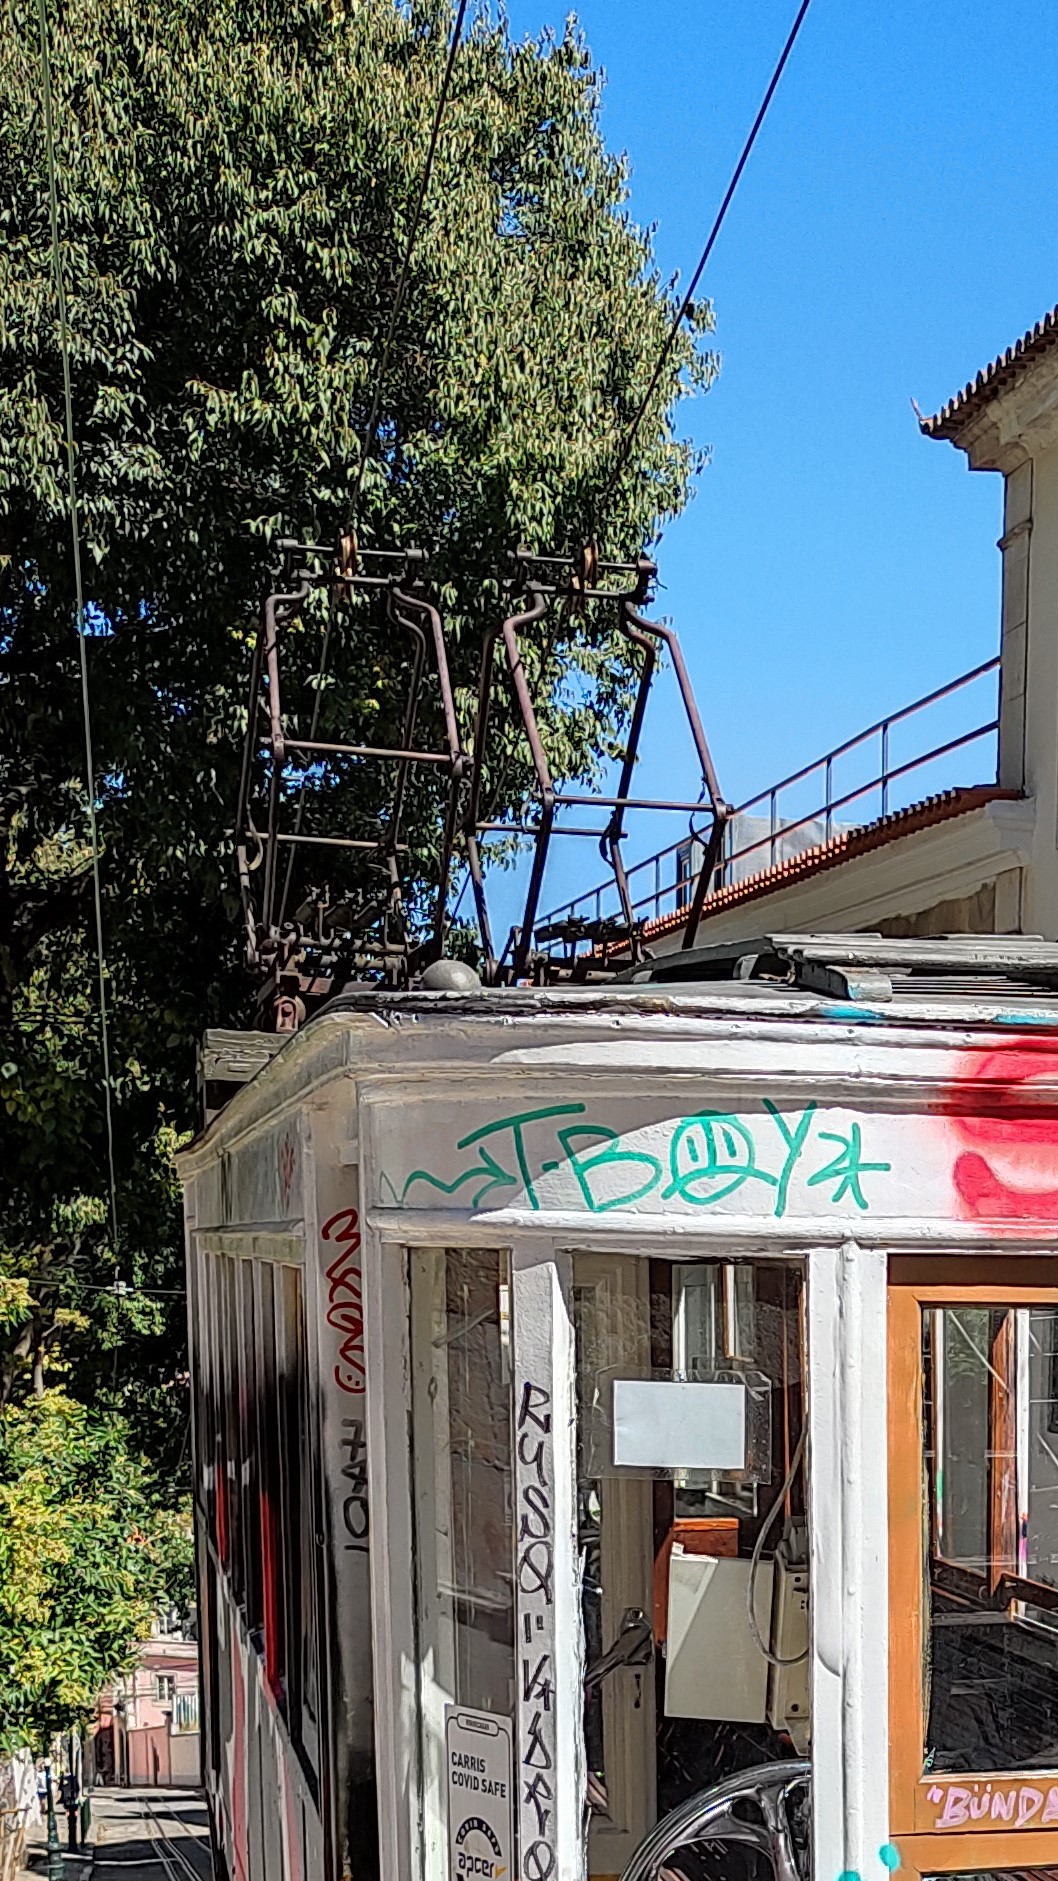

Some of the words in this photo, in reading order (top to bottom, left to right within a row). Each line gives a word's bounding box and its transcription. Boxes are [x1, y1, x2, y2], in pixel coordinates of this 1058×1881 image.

[451, 1751, 486, 1773] CARRIS
[451, 1770, 480, 1791] COVID
[480, 1778, 507, 1798] SAFE
